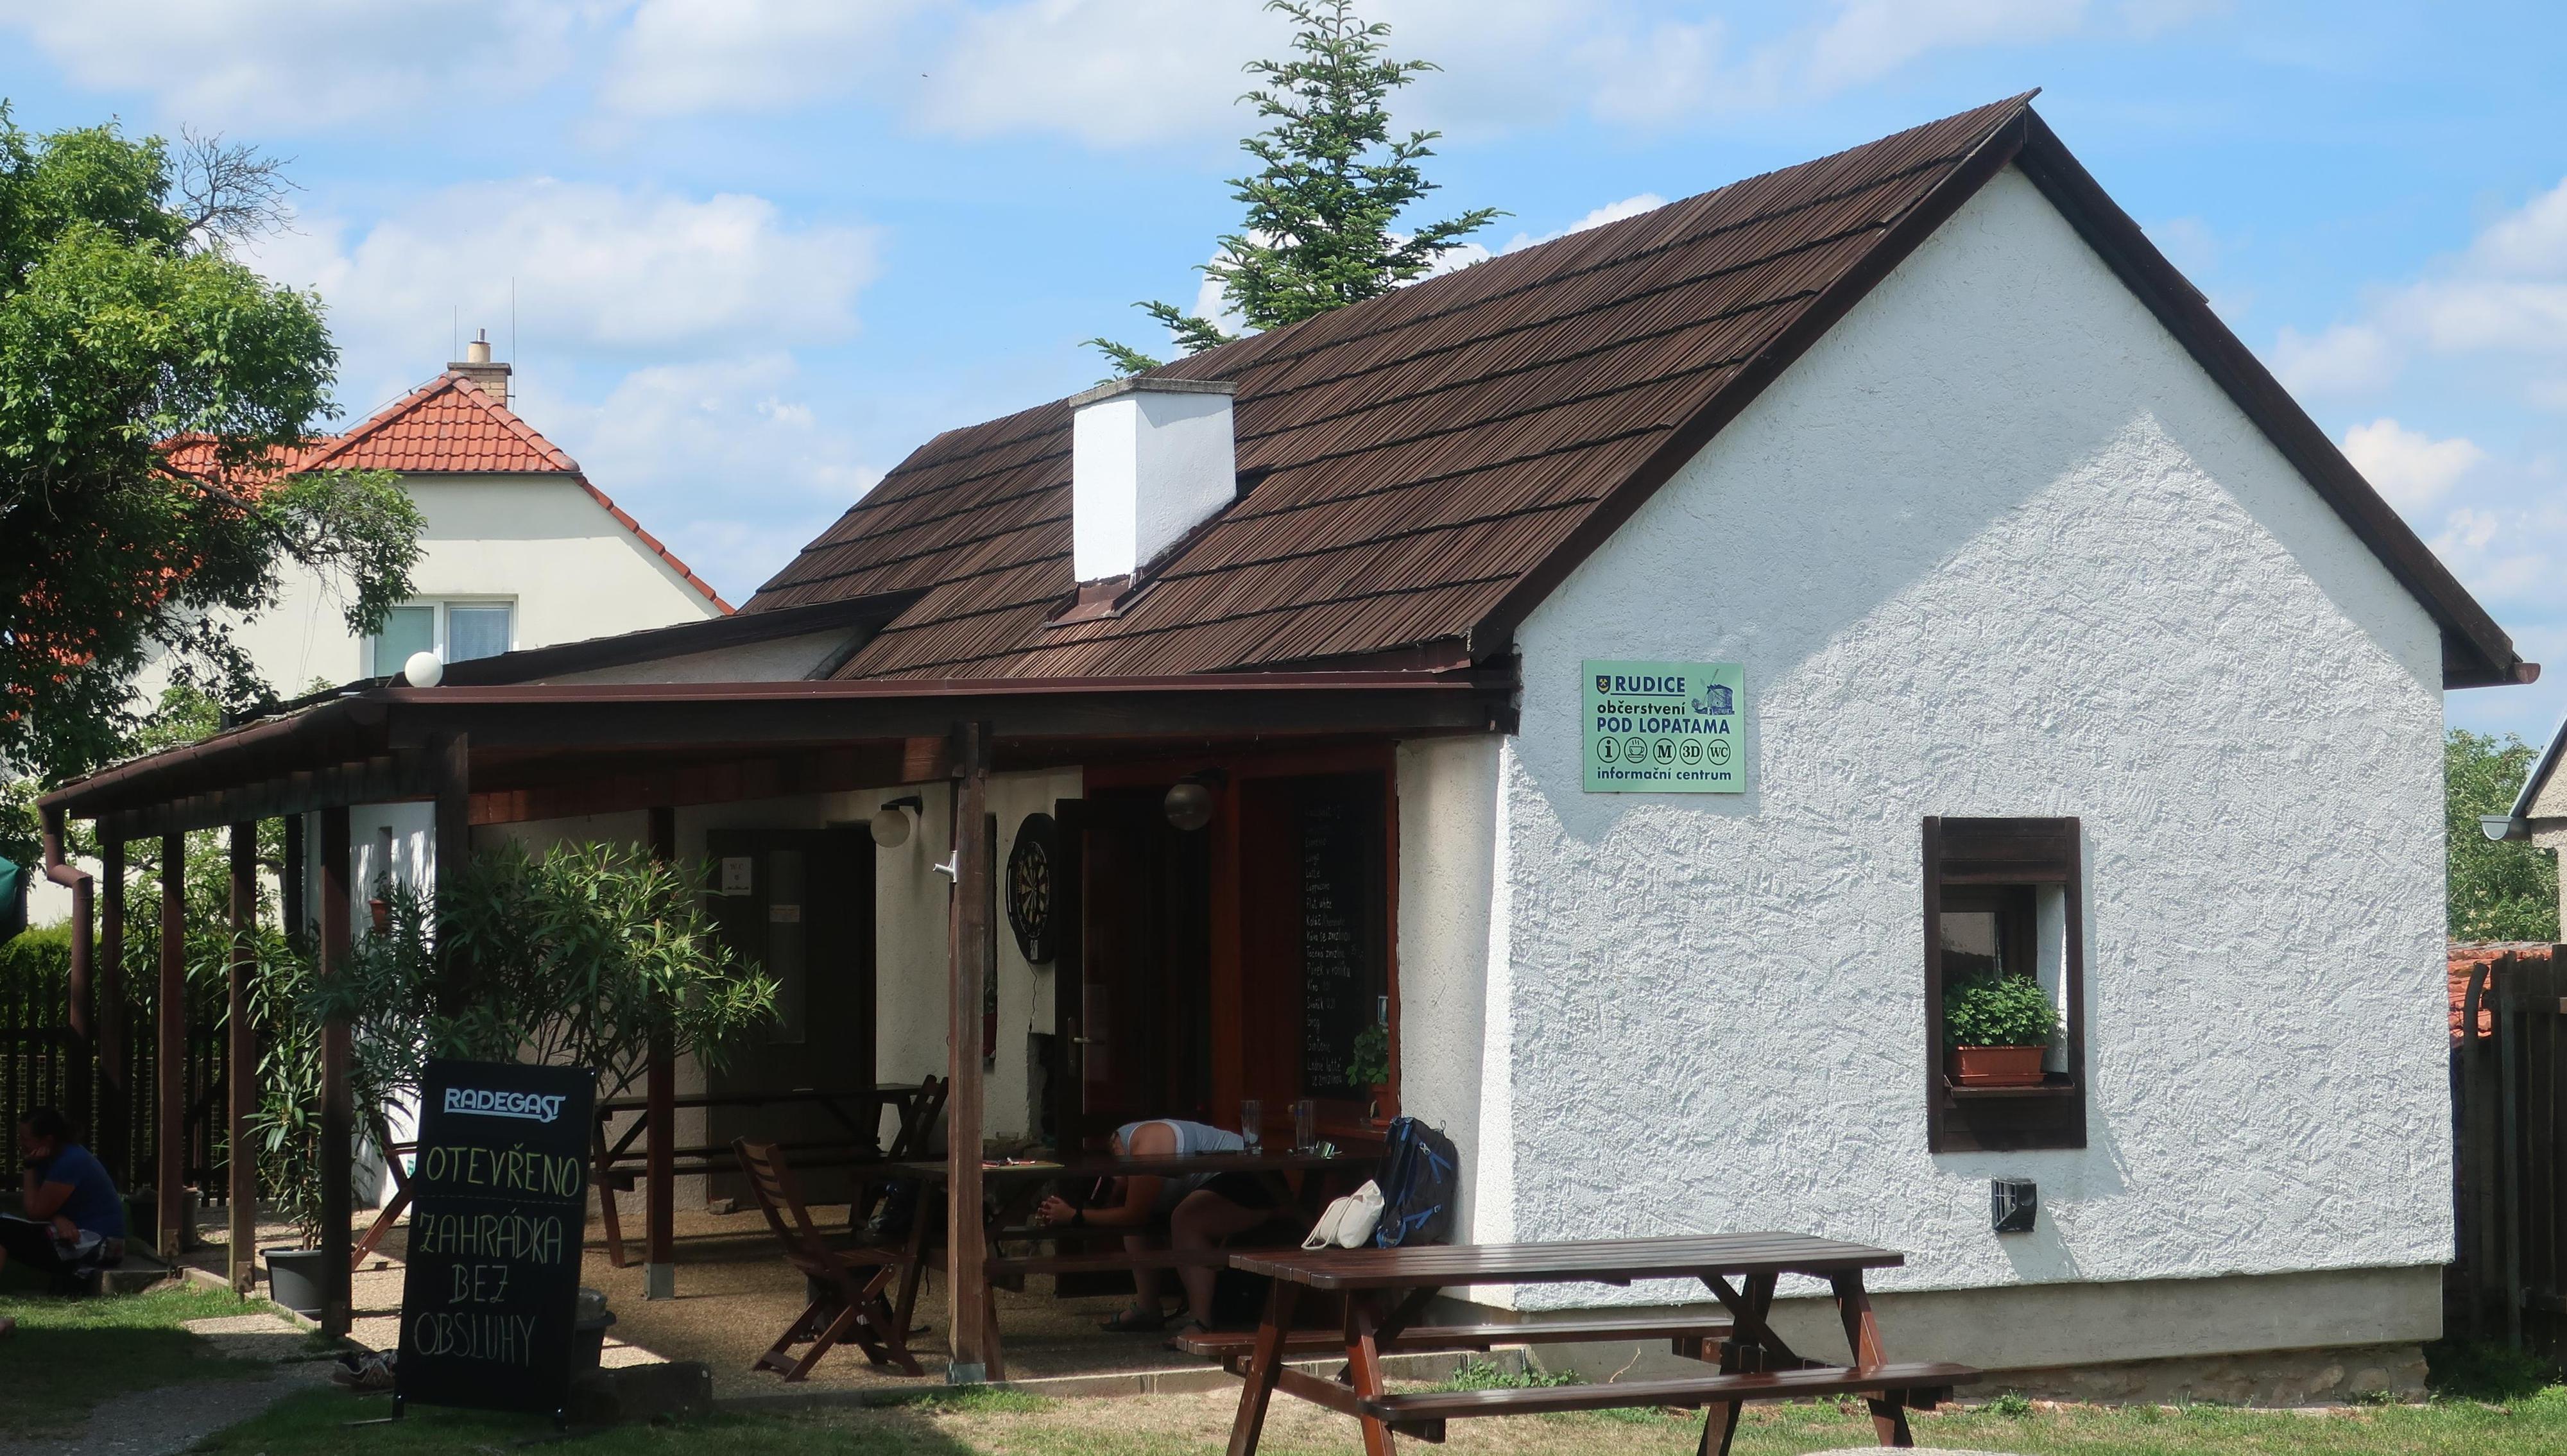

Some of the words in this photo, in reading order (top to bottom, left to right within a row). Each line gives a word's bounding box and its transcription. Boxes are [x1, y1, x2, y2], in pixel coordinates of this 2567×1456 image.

[1615, 676, 1685, 693] RUDICE
[1597, 700, 1686, 715] občerstvení
[1597, 717, 1632, 733] POD
[1640, 717, 1730, 734] LOPATAMA
[1657, 745, 1672, 758] M
[1683, 746, 1700, 758] 3D
[1710, 747, 1728, 758] WC
[1597, 767, 1671, 780] informační
[1676, 769, 1731, 780] centrum
[444, 1088, 566, 1123] RADEGAST
[426, 1143, 579, 1197] OTEVŘENO
[418, 1207, 562, 1264] ZAHRÁDKA
[449, 1263, 509, 1304] BEZ
[414, 1312, 536, 1367] OBSLUHY
